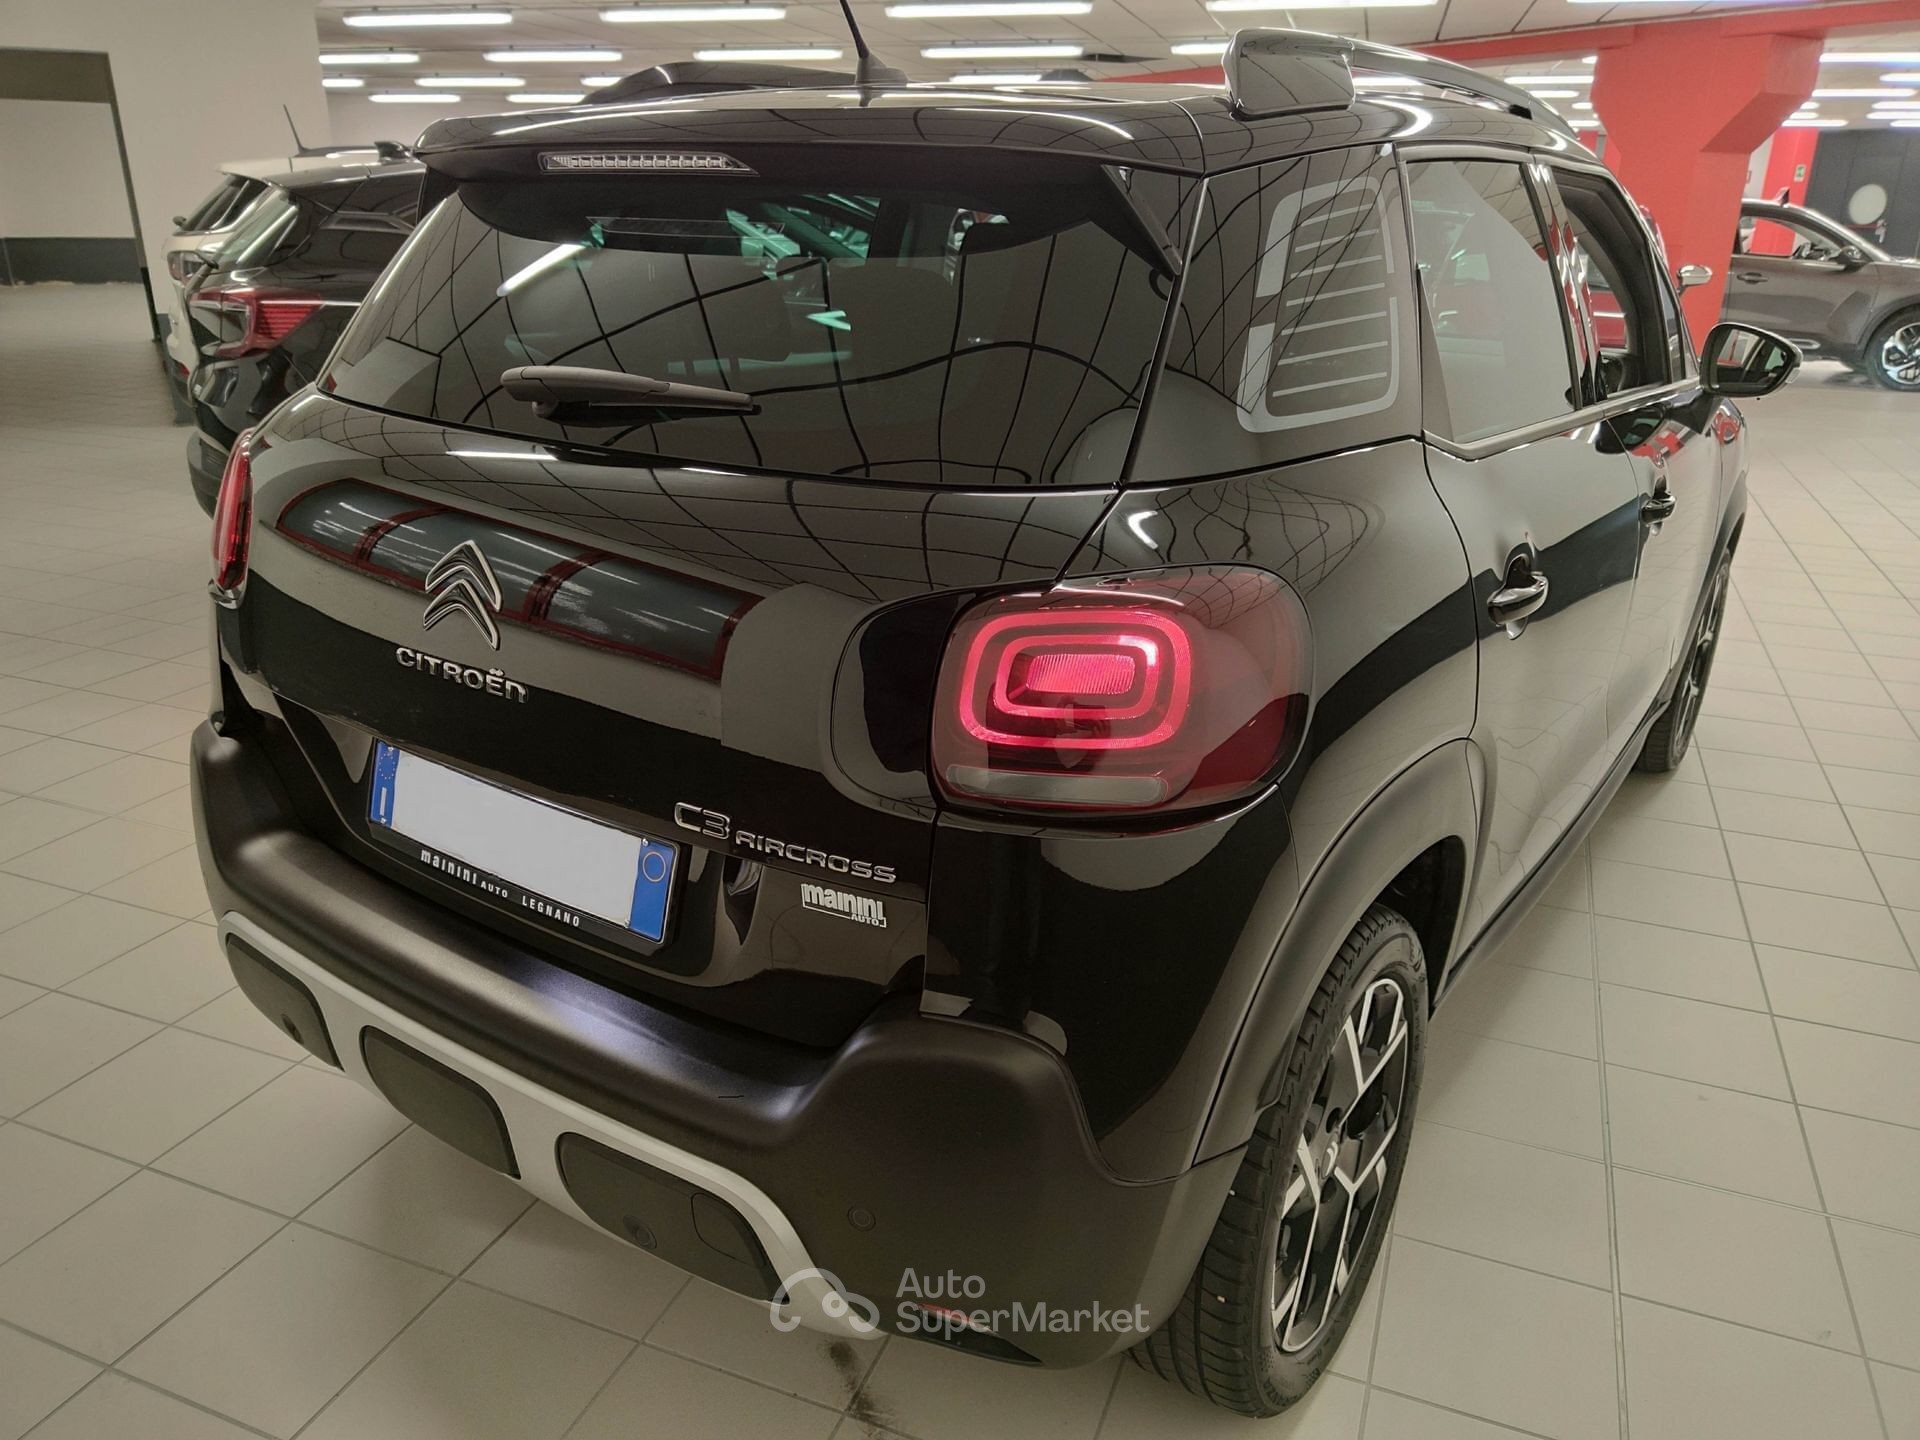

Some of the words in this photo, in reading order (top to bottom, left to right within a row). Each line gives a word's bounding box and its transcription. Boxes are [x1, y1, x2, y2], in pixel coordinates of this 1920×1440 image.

[674, 802, 731, 840] C3
[735, 830, 897, 883] AIRCROSS
[421, 849, 478, 885] mainini
[480, 881, 509, 899] AUTO
[522, 896, 580, 927] LEGNANO
[803, 884, 884, 921] mainini
[851, 913, 880, 928] AUTO
